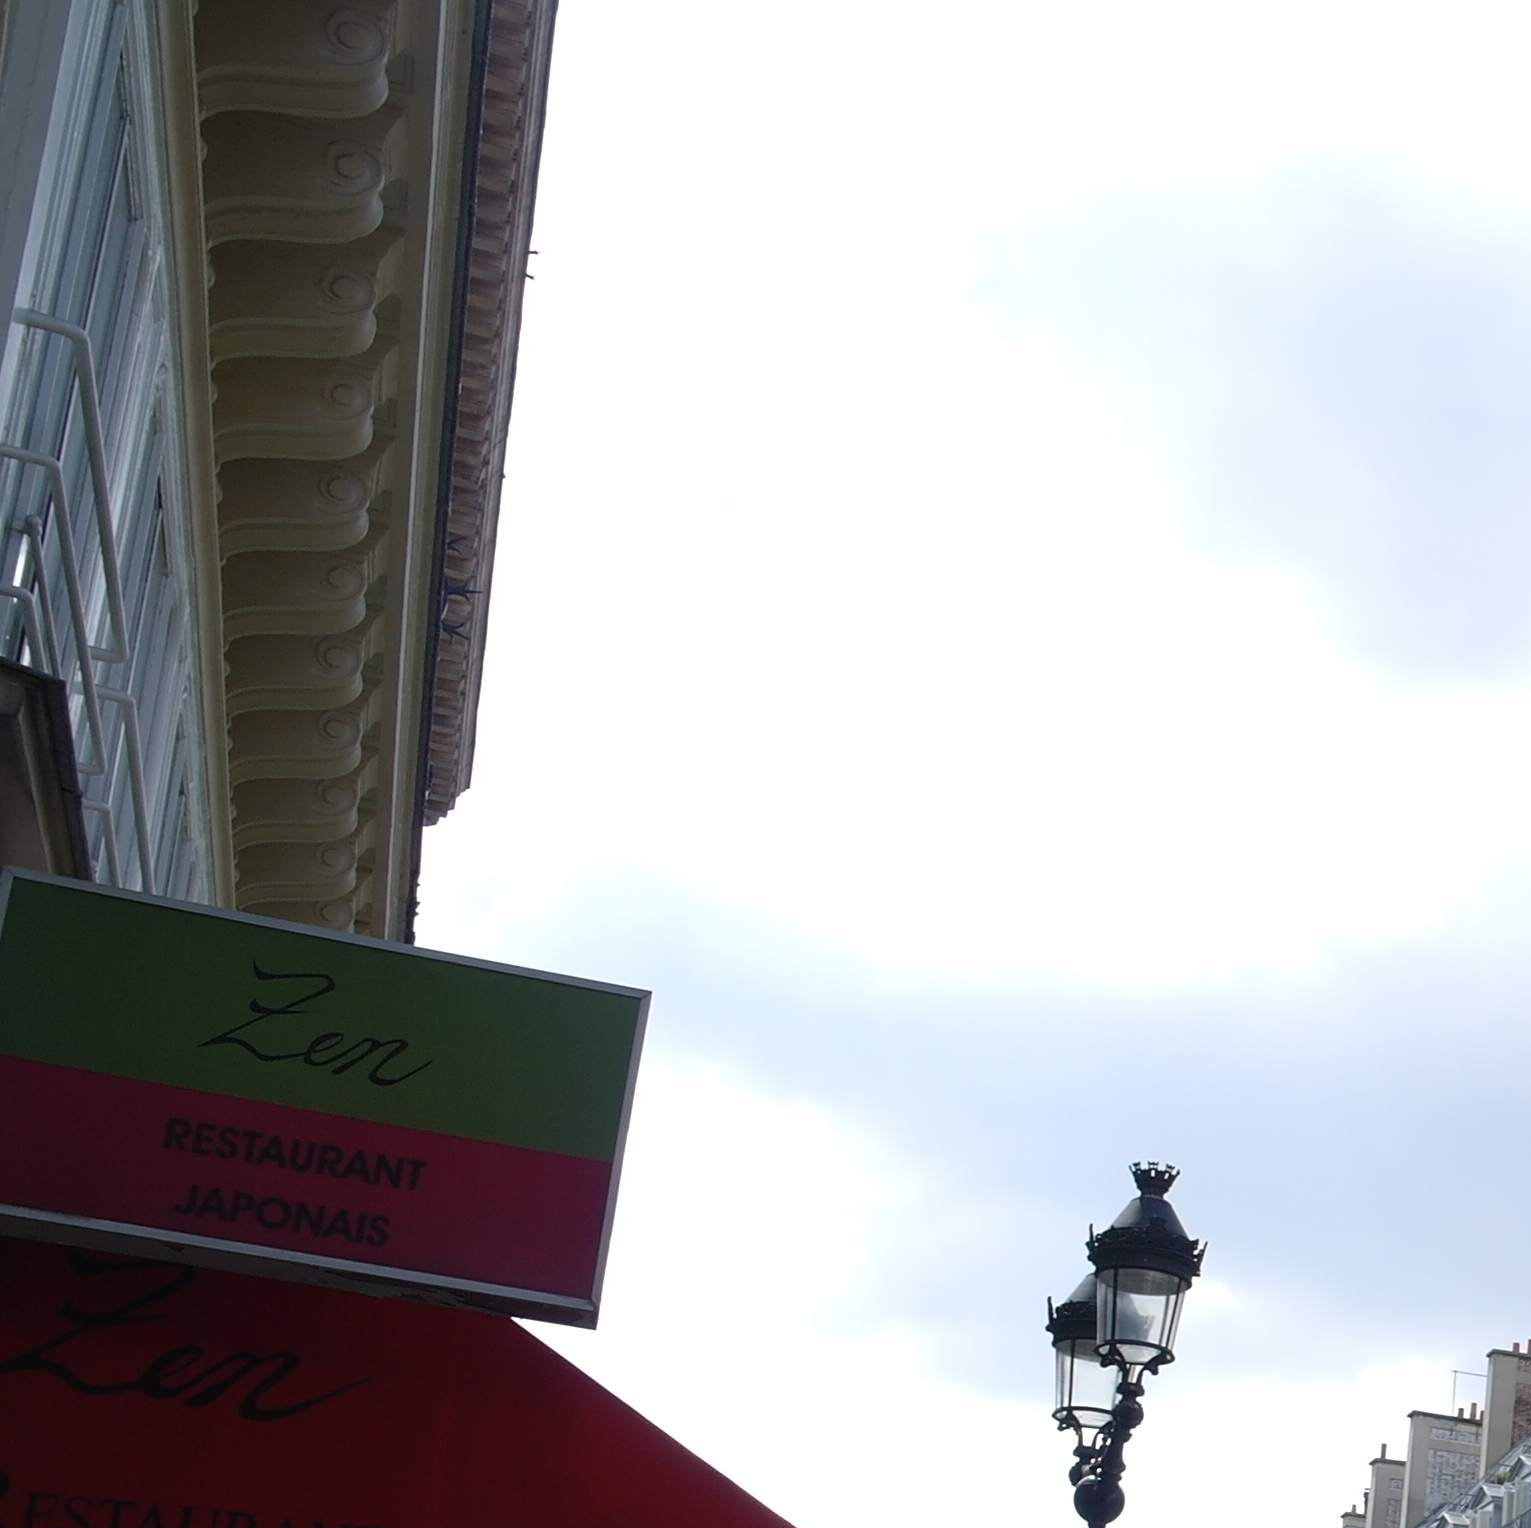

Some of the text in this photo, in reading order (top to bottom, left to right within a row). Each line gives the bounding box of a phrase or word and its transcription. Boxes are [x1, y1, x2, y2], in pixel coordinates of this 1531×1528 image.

[197, 957, 433, 1086] Zen
[162, 1117, 428, 1191] RESTAURANT
[174, 1184, 391, 1248] JAPONAIS
[0, 1245, 369, 1421] Zen
